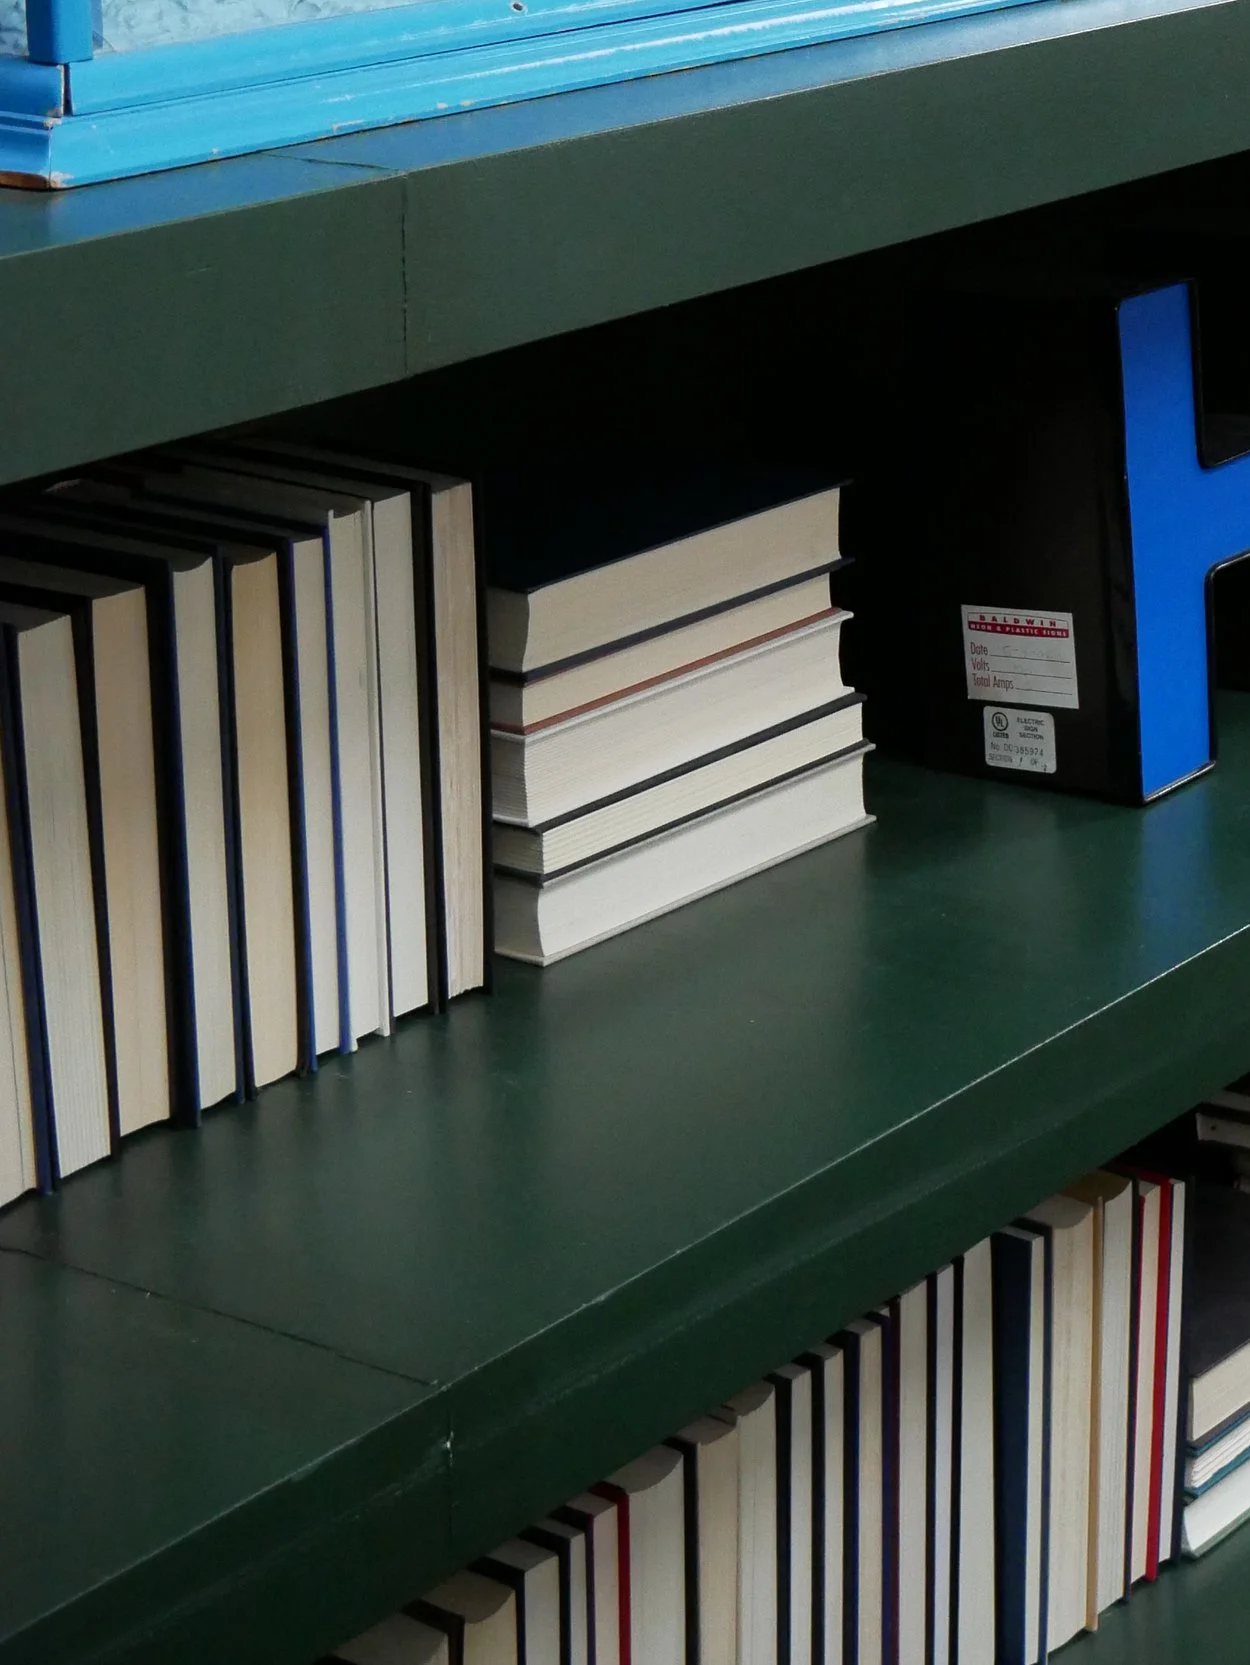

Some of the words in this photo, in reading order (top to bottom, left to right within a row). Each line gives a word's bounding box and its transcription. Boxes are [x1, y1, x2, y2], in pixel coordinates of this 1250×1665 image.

[979, 615, 1057, 627] BALDWIN
[1005, 626, 1040, 635] PLASTIC
[1042, 629, 1067, 637] SIGNS
[970, 642, 988, 655] Date
[971, 658, 990, 671] Volts
[972, 672, 990, 687] Total
[992, 675, 1014, 691] Amps
